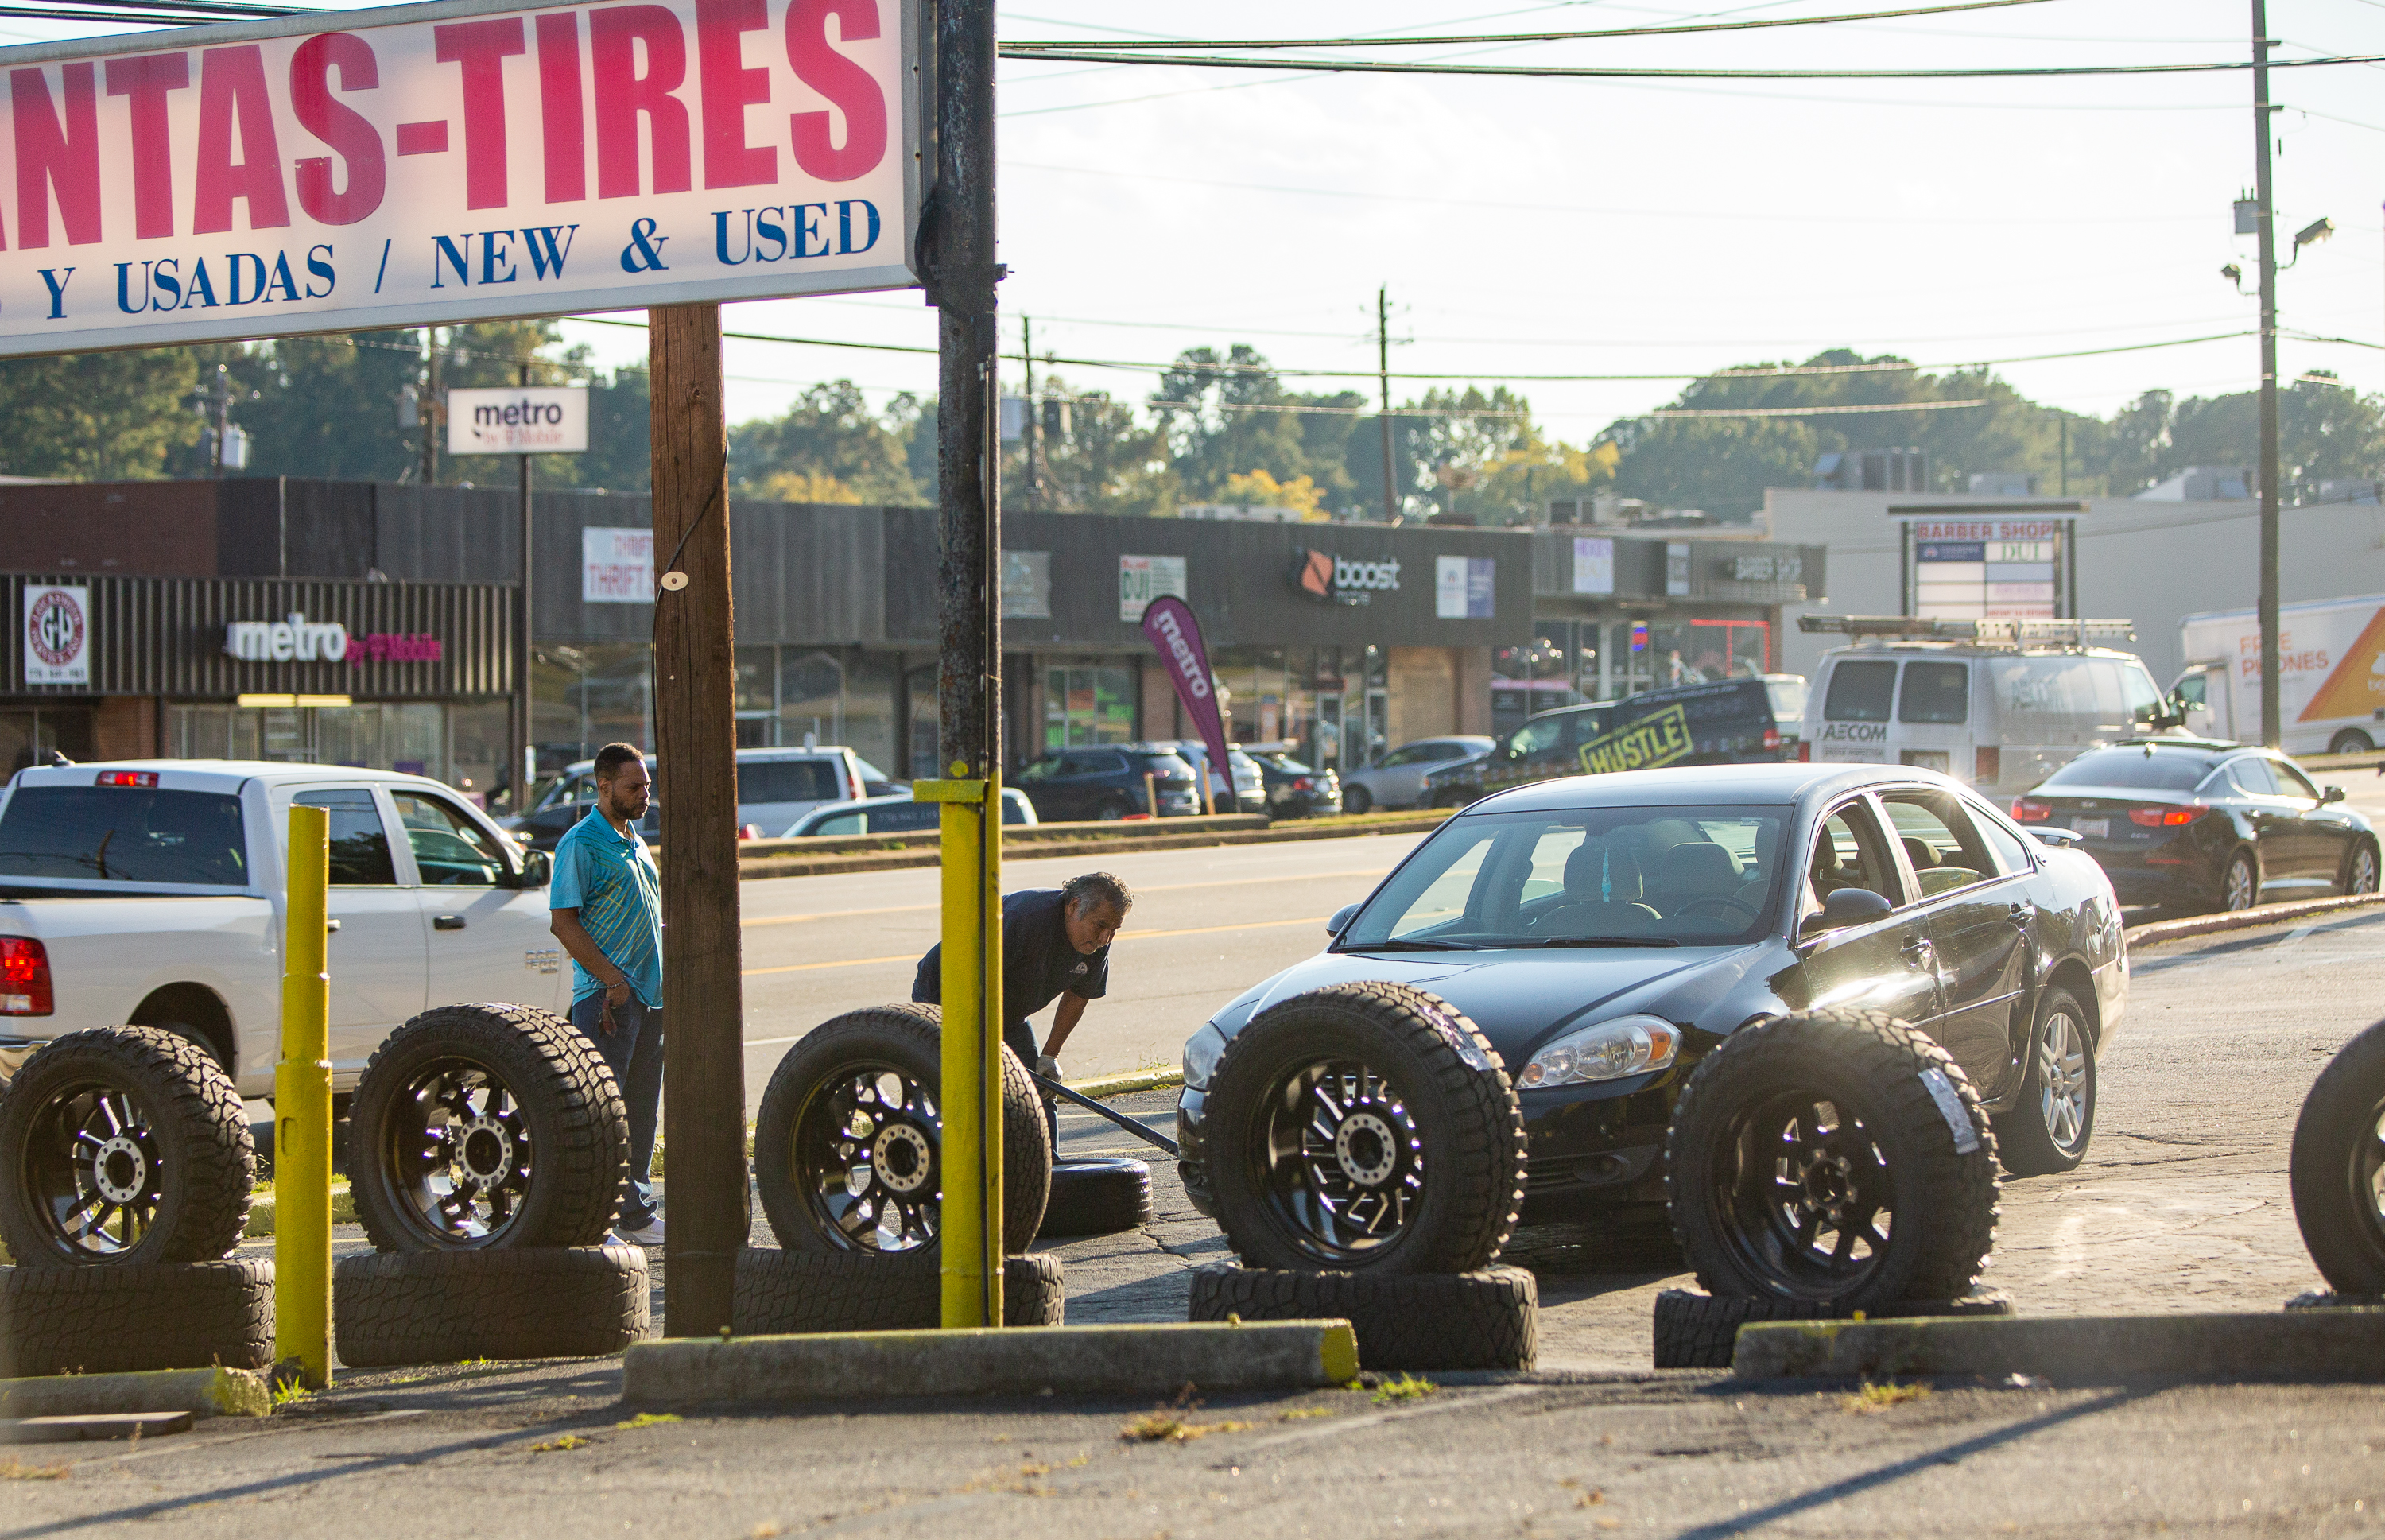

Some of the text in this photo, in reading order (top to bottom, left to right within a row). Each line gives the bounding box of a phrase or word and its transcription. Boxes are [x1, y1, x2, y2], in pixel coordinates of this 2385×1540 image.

[0, 0, 888, 252] NTAS-TIRES
[37, 267, 76, 319] Y
[114, 244, 336, 314] USADAS
[430, 224, 580, 288] NEW
[620, 217, 669, 274] &
[711, 198, 882, 266] USED
[475, 398, 563, 426] metro
[1917, 522, 2053, 539] BARBER SHOP
[2001, 542, 2040, 561] DUI
[589, 564, 644, 595] THRIFT
[1335, 554, 1401, 590] boost
[226, 611, 348, 662] metro
[1156, 609, 1209, 699] metro
[1589, 715, 1685, 774] HUSTLE
[1823, 723, 1888, 743] AECOM
